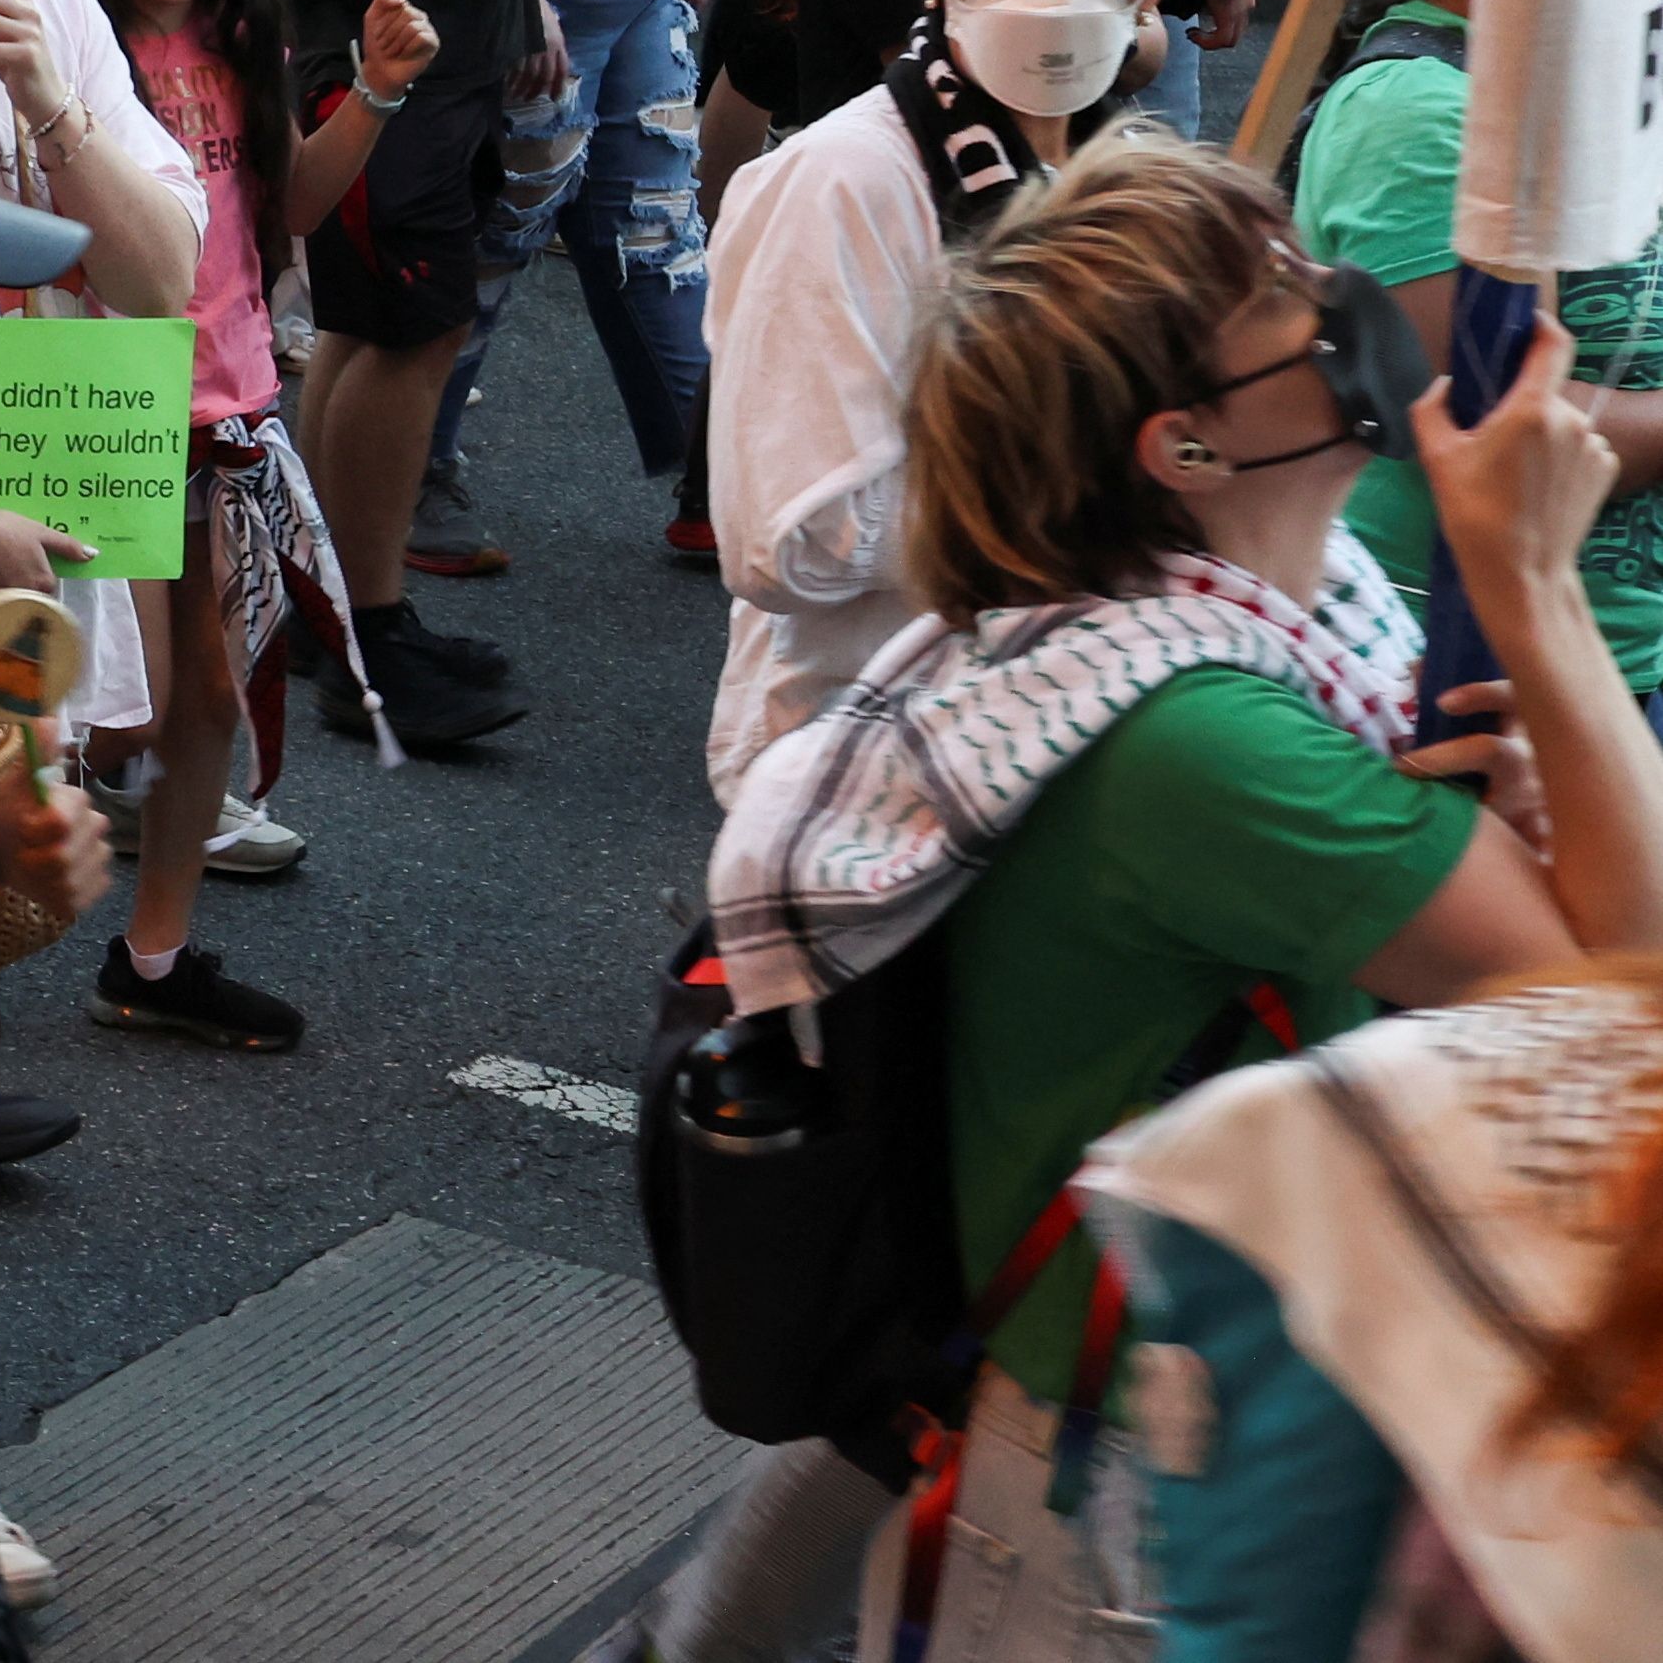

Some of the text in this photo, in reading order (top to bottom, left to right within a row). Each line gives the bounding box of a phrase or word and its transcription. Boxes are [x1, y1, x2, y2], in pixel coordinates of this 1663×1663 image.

[1, 382, 155, 410] didn't have
[65, 429, 180, 454] wouldn't
[43, 474, 68, 497] to
[78, 473, 174, 499] silence
